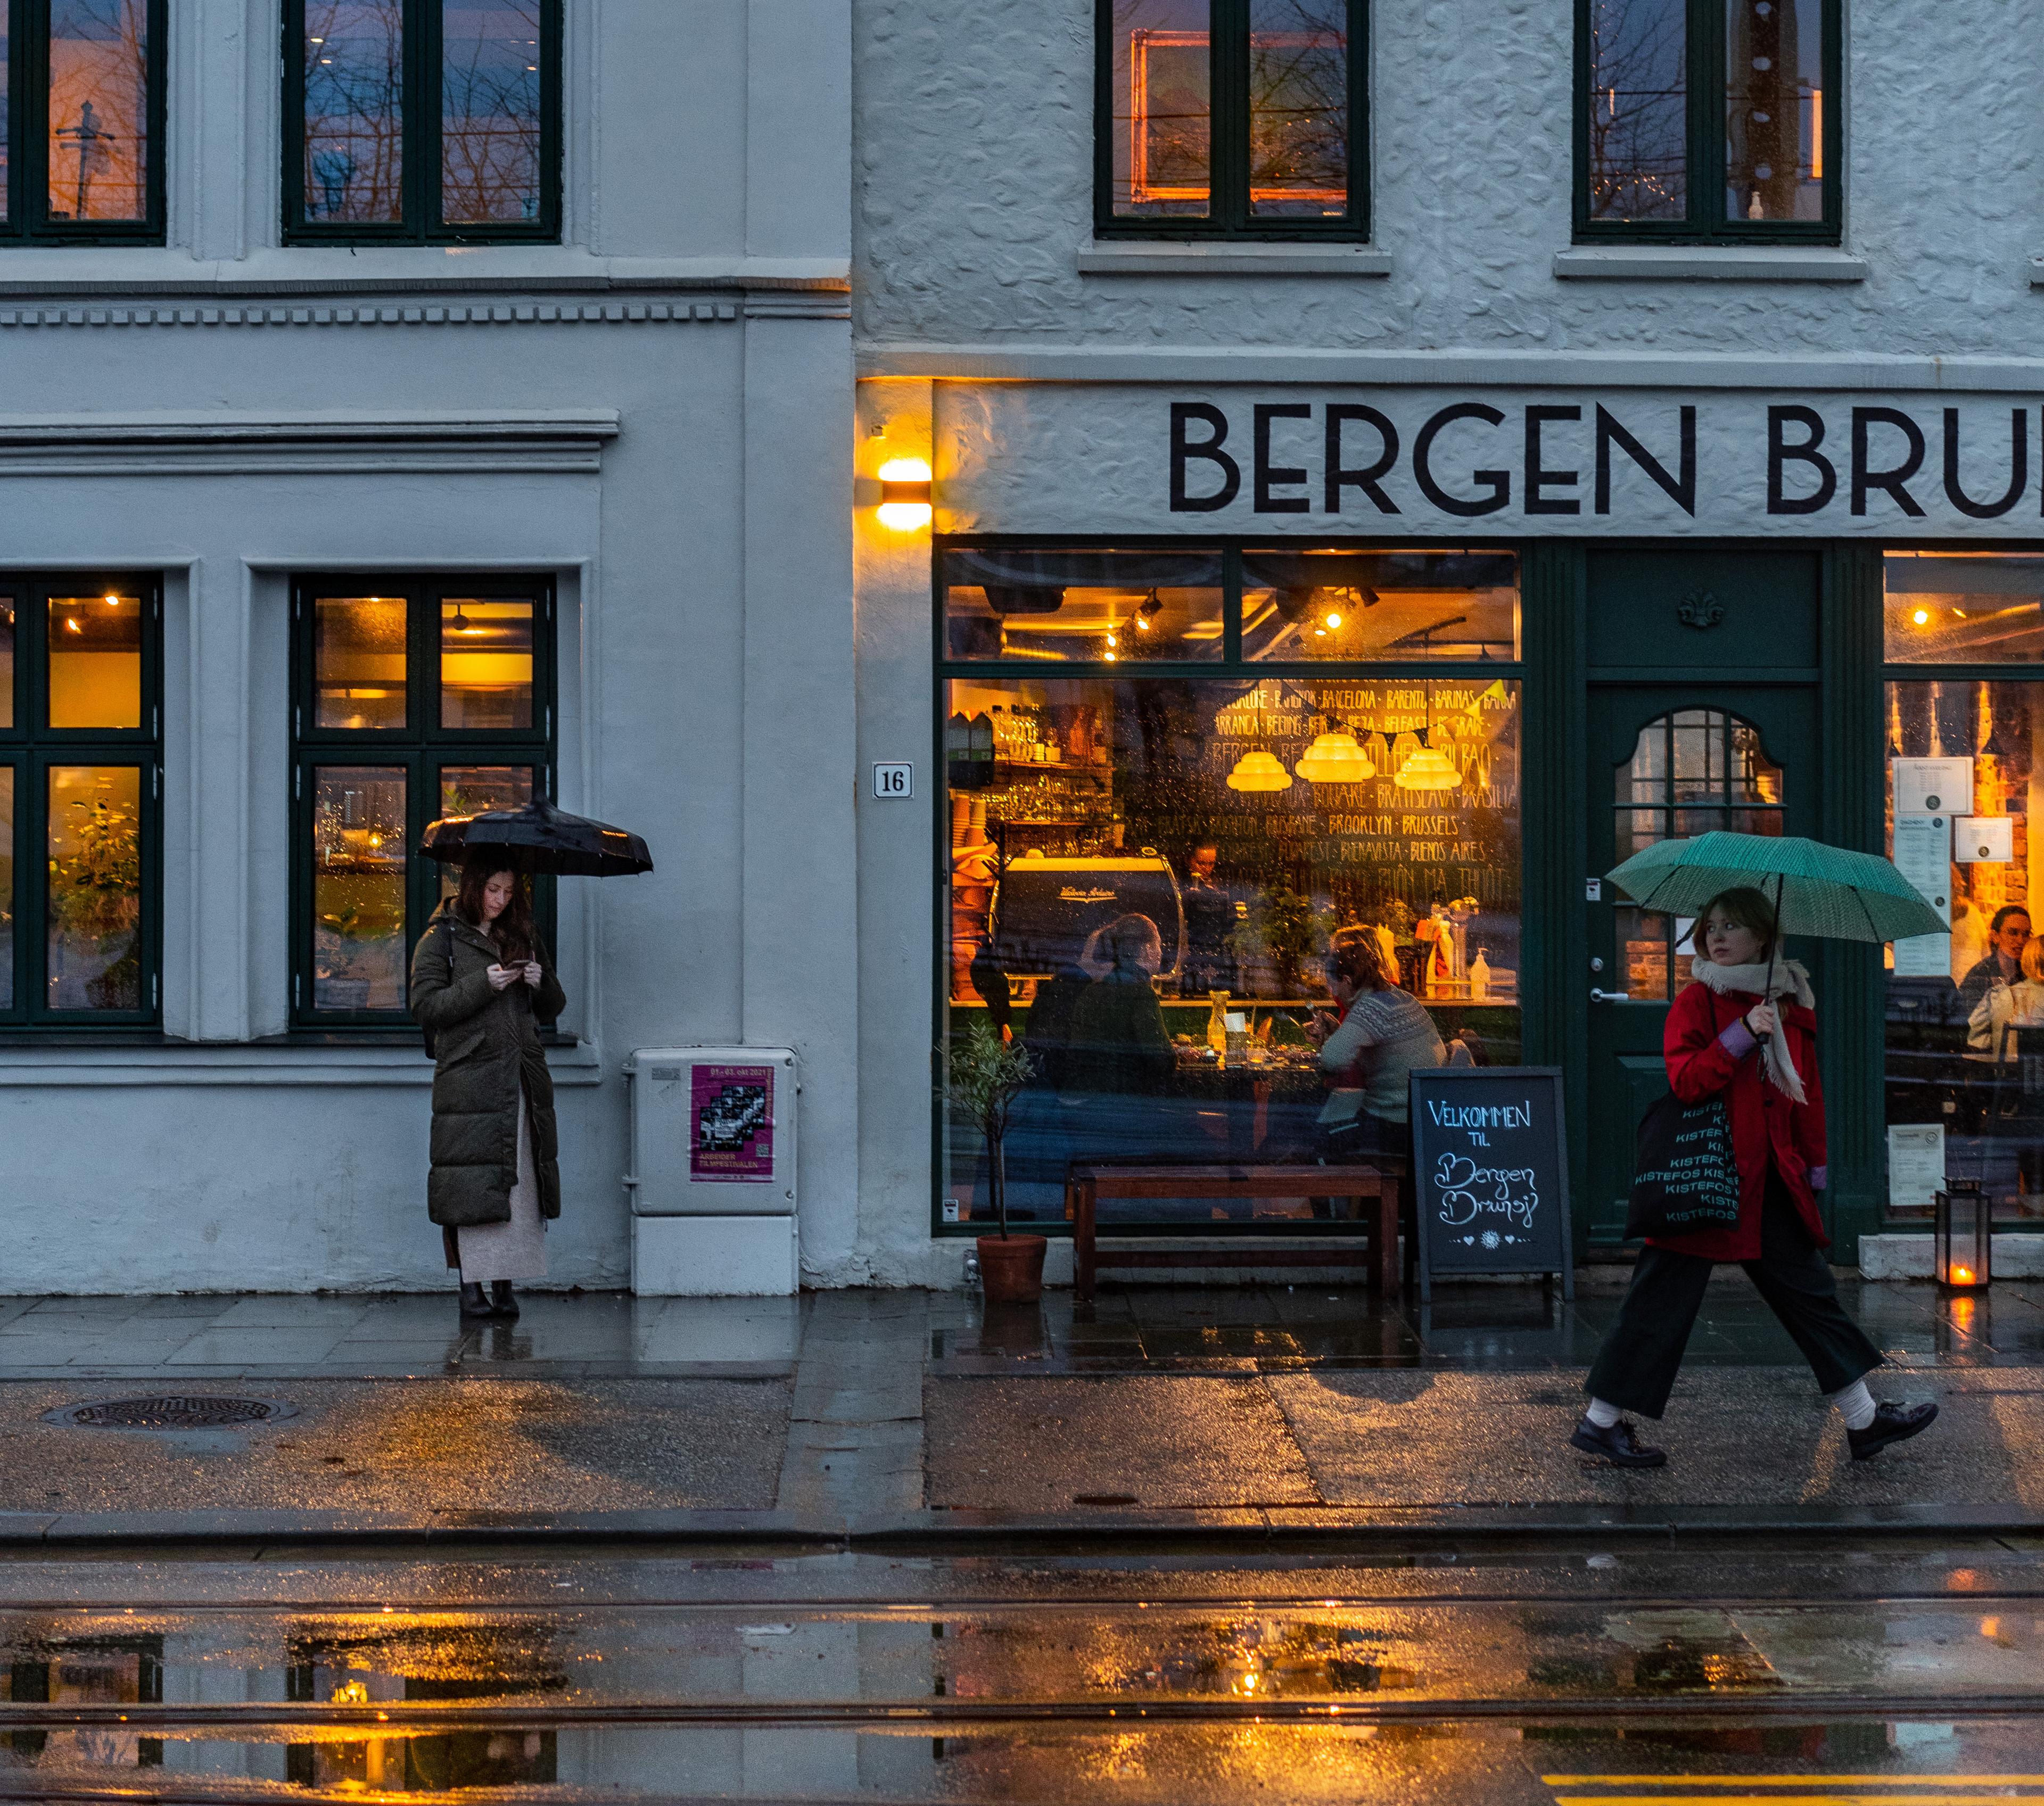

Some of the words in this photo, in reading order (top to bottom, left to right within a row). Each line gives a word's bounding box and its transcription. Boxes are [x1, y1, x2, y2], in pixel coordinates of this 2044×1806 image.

[1169, 402, 1696, 518] BERGEN
[1767, 405, 2044, 517] BRU
[882, 770, 904, 791] 16
[1329, 815, 1392, 835] BROOKLYN
[1402, 814, 1459, 836] BRUSSELS
[1410, 841, 1446, 862] BUENOS
[1450, 841, 1486, 862] AIRES
[1428, 1100, 1531, 1128] VELKOMMEN
[1468, 1132, 1491, 1147] TIL
[1434, 1152, 1537, 1200] Bergen
[1635, 1169, 1700, 1186] KISTEFOS
[1666, 1181, 1732, 1195] KISTEFOS
[1666, 1208, 1737, 1222] KISTEFOS
